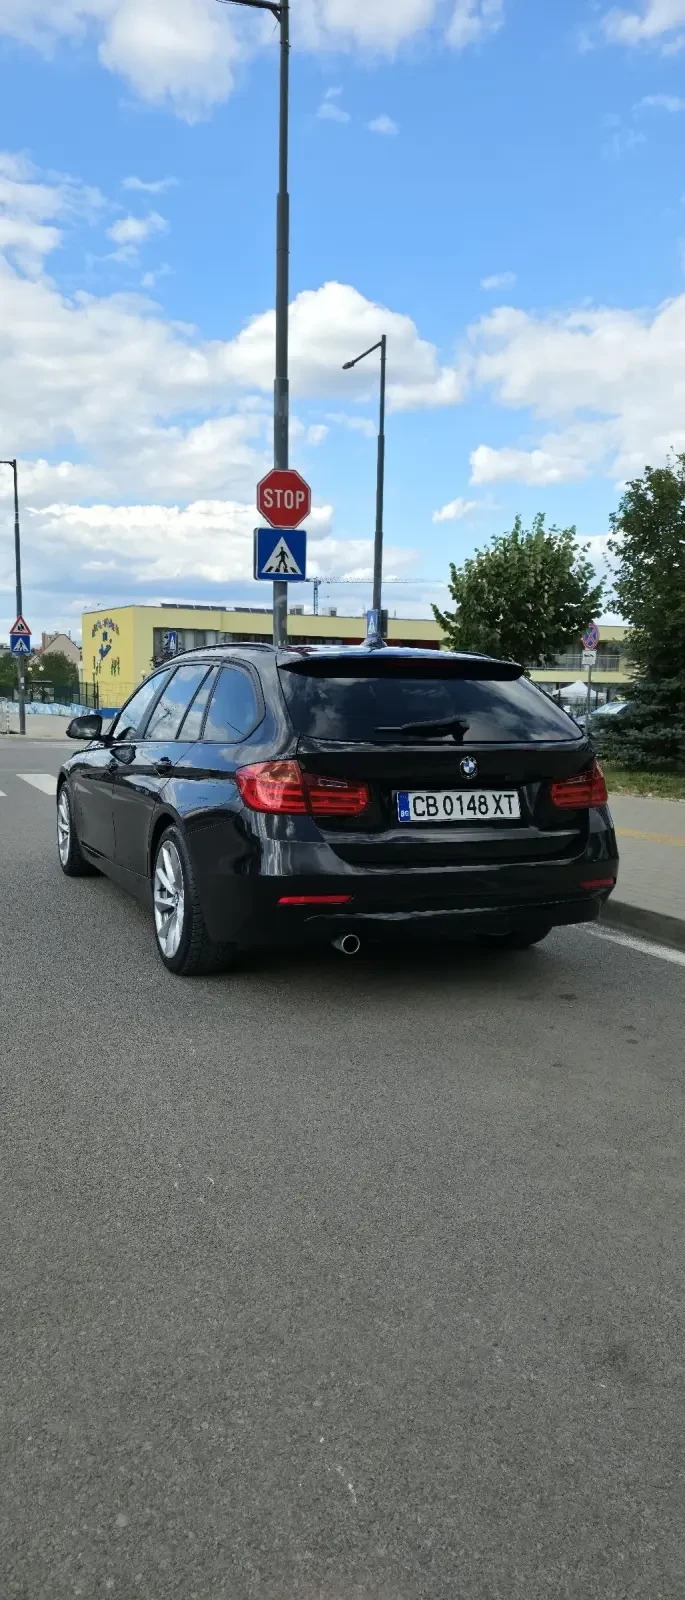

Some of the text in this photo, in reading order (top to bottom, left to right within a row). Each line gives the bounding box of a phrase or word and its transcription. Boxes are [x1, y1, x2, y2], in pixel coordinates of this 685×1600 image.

[263, 488, 305, 509] STOP
[400, 810, 410, 818] BG
[413, 794, 515, 817] CB 0148 XT
